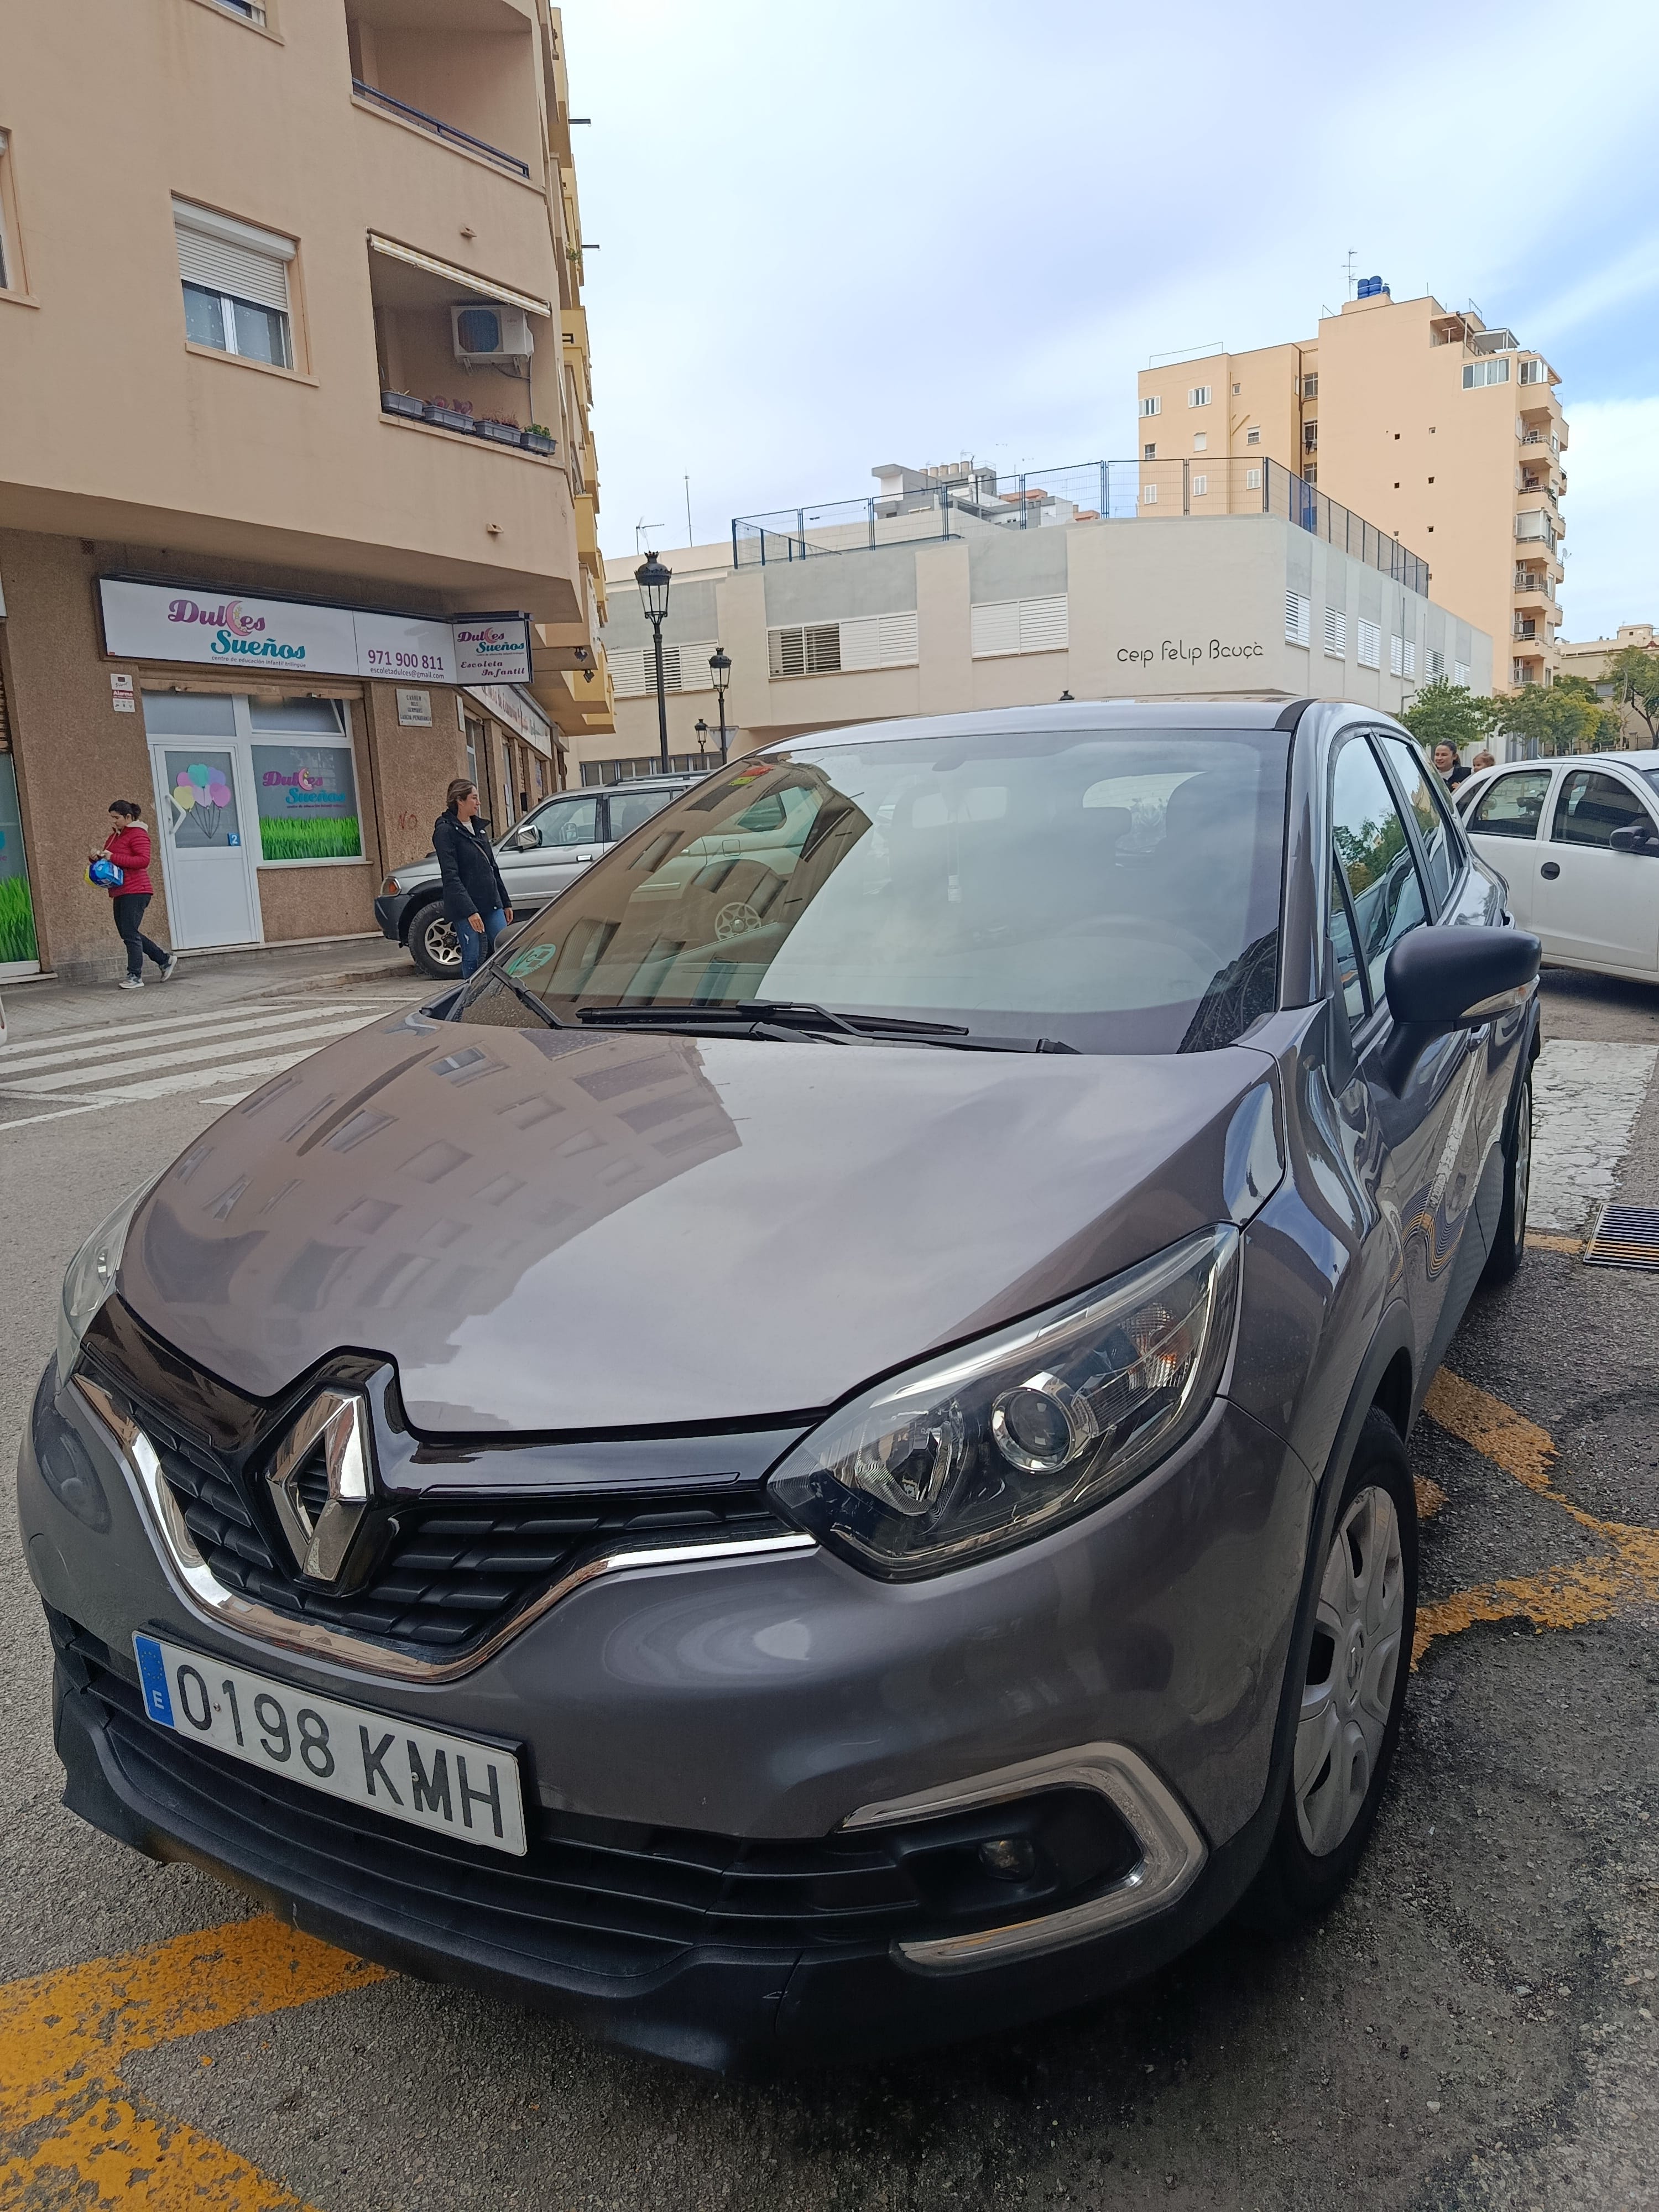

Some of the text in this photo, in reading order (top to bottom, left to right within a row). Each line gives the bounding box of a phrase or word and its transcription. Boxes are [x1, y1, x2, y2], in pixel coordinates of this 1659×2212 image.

[211, 629, 305, 659] Sueños
[476, 641, 524, 653] Sueños
[1117, 649, 1154, 667] ceip
[1209, 639, 1264, 659] Bauçà
[368, 649, 444, 670] 971 900 811
[370, 667, 445, 680] escoletadulces@gmail.com
[482, 667, 525, 677] Infantil
[285, 787, 346, 804] Sueños
[231, 834, 238, 844] 2
[152, 1689, 164, 1710] E
[176, 1664, 504, 1838] 0198 KMH
